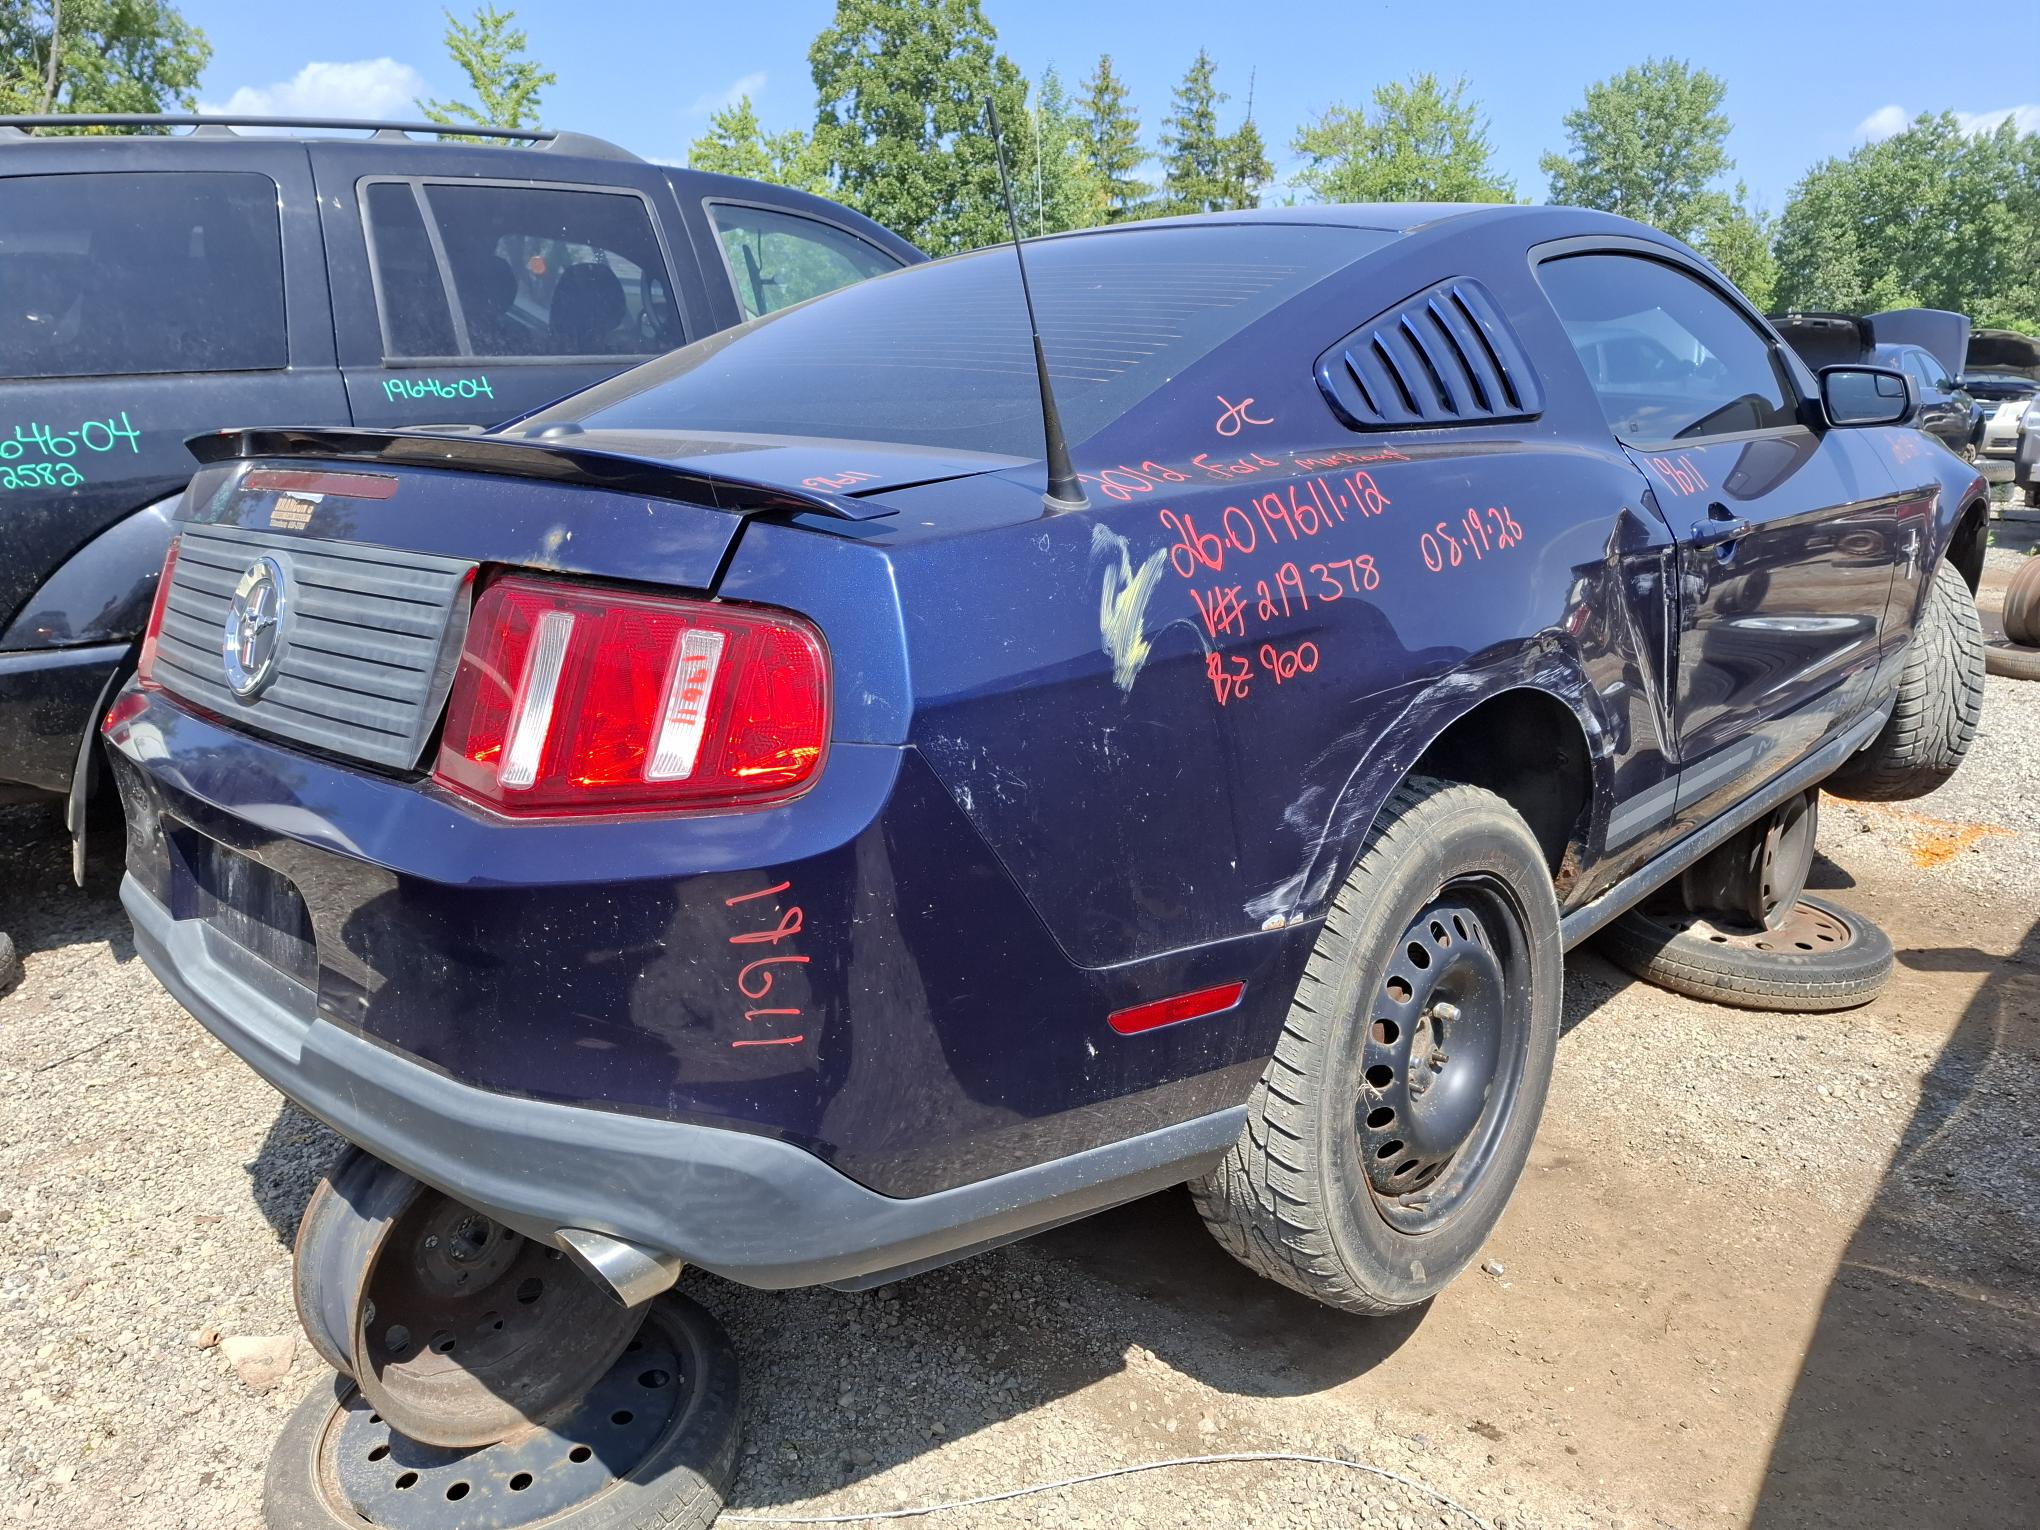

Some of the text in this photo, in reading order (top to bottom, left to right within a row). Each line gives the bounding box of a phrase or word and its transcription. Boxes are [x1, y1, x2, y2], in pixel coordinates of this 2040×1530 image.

[382, 375, 495, 402] 19646-04
[1076, 461, 1193, 500] 2012
[1643, 455, 1709, 496] 19611
[1259, 641, 1320, 685] 900
[671, 655, 709, 726] 19611
[725, 880, 812, 1048] 19611
